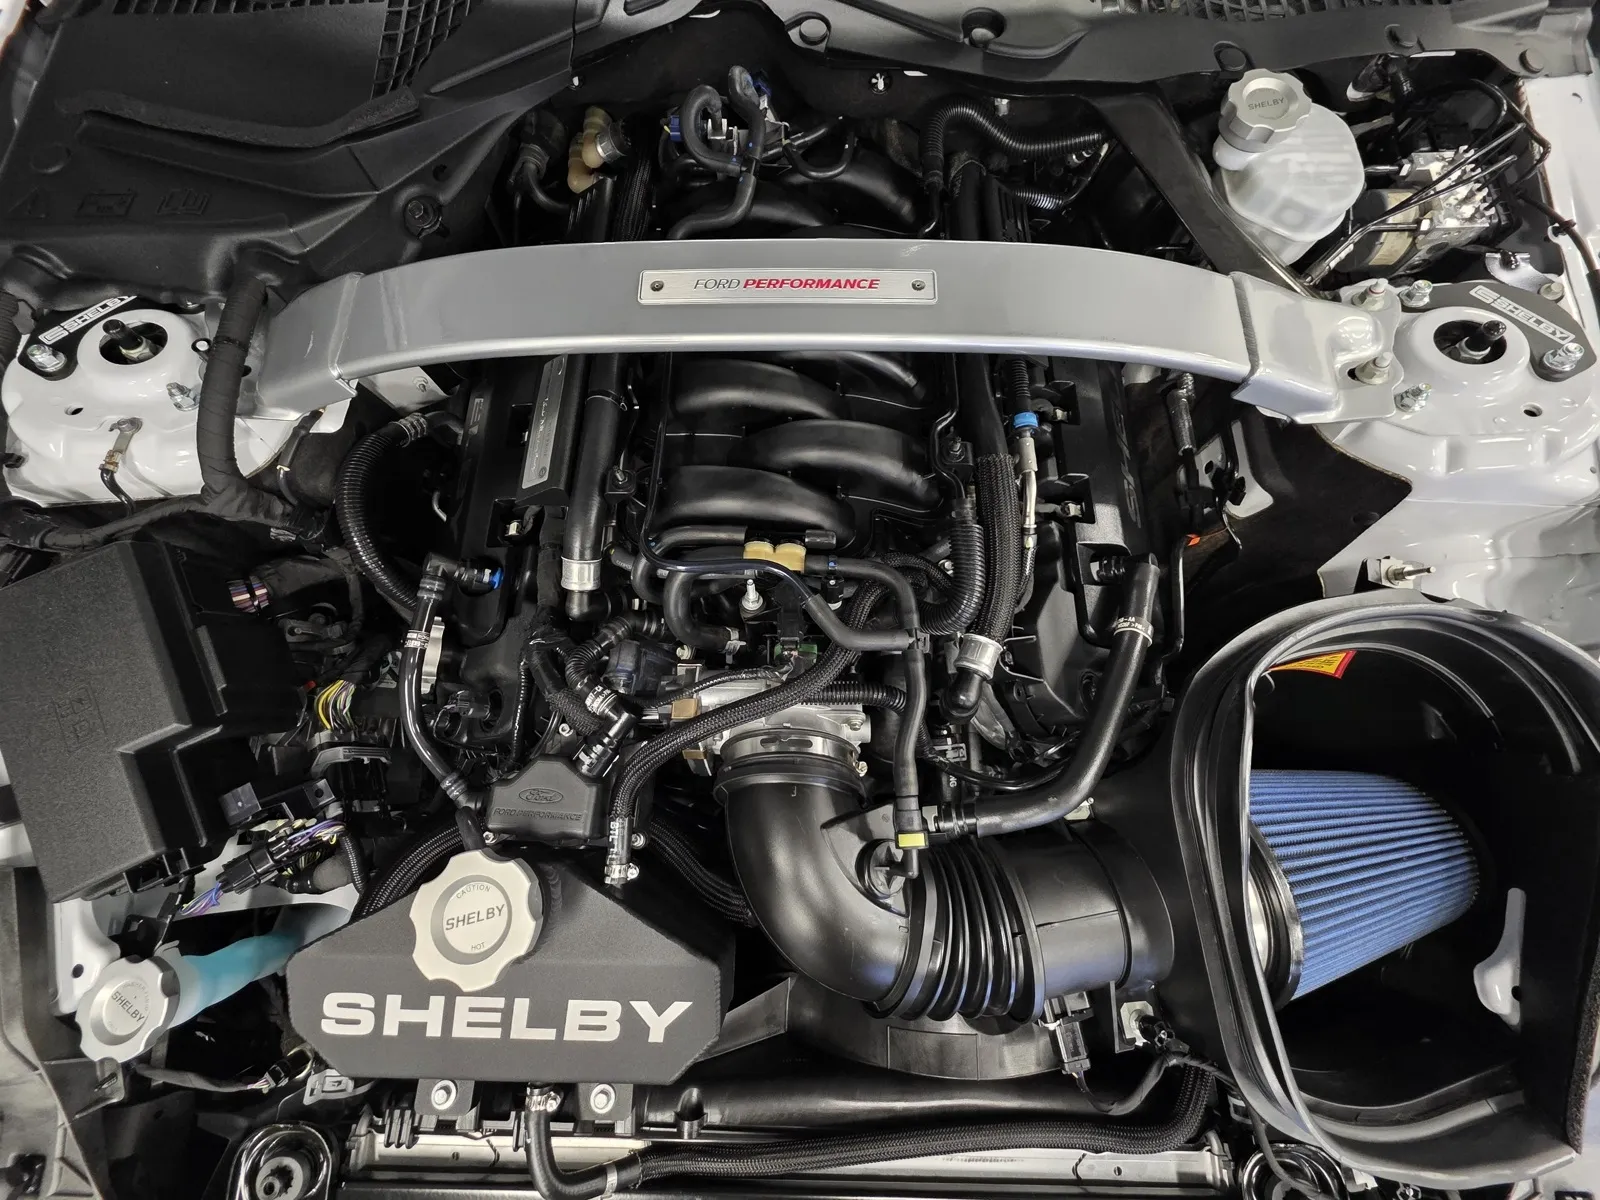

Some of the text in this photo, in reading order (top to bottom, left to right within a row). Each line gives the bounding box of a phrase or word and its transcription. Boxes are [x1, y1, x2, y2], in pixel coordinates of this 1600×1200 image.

[1248, 97, 1284, 110] SHELBY
[693, 278, 880, 290] FORD PERFORMANCE
[456, 884, 491, 899] CAUTION
[445, 903, 505, 931] SHELBY
[470, 942, 485, 952] HOT
[111, 990, 145, 1022] SHELBY
[321, 992, 693, 1043] SHELBY
